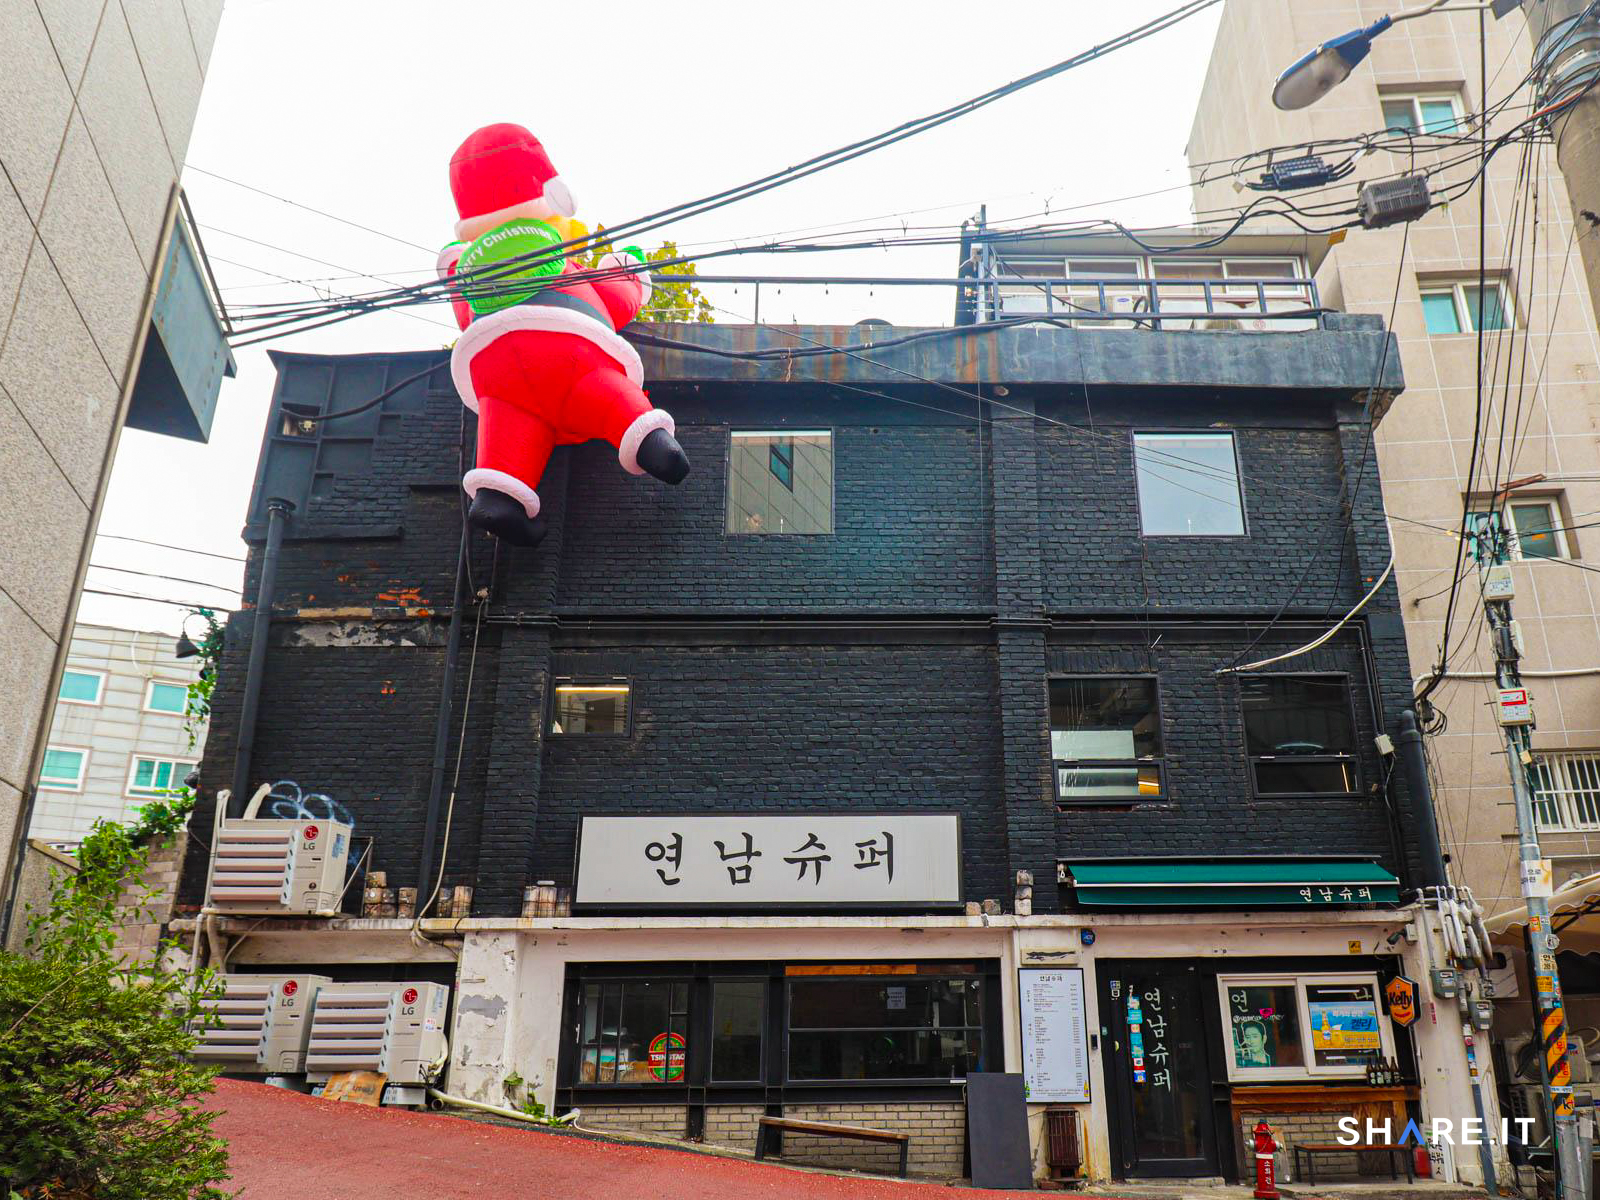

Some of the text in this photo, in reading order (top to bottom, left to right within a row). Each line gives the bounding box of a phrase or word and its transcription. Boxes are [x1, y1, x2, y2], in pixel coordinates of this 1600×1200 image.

[303, 842, 315, 851] LG
[645, 831, 895, 886] 연남슈퍼
[1300, 886, 1372, 902] 연남슈퍼
[1231, 990, 1249, 1013] 연
[1389, 991, 1412, 1010] Kelly
[401, 1007, 414, 1016] LG
[1145, 988, 1171, 1092] 연남슈퍼
[651, 1053, 685, 1061] TSINTAO
